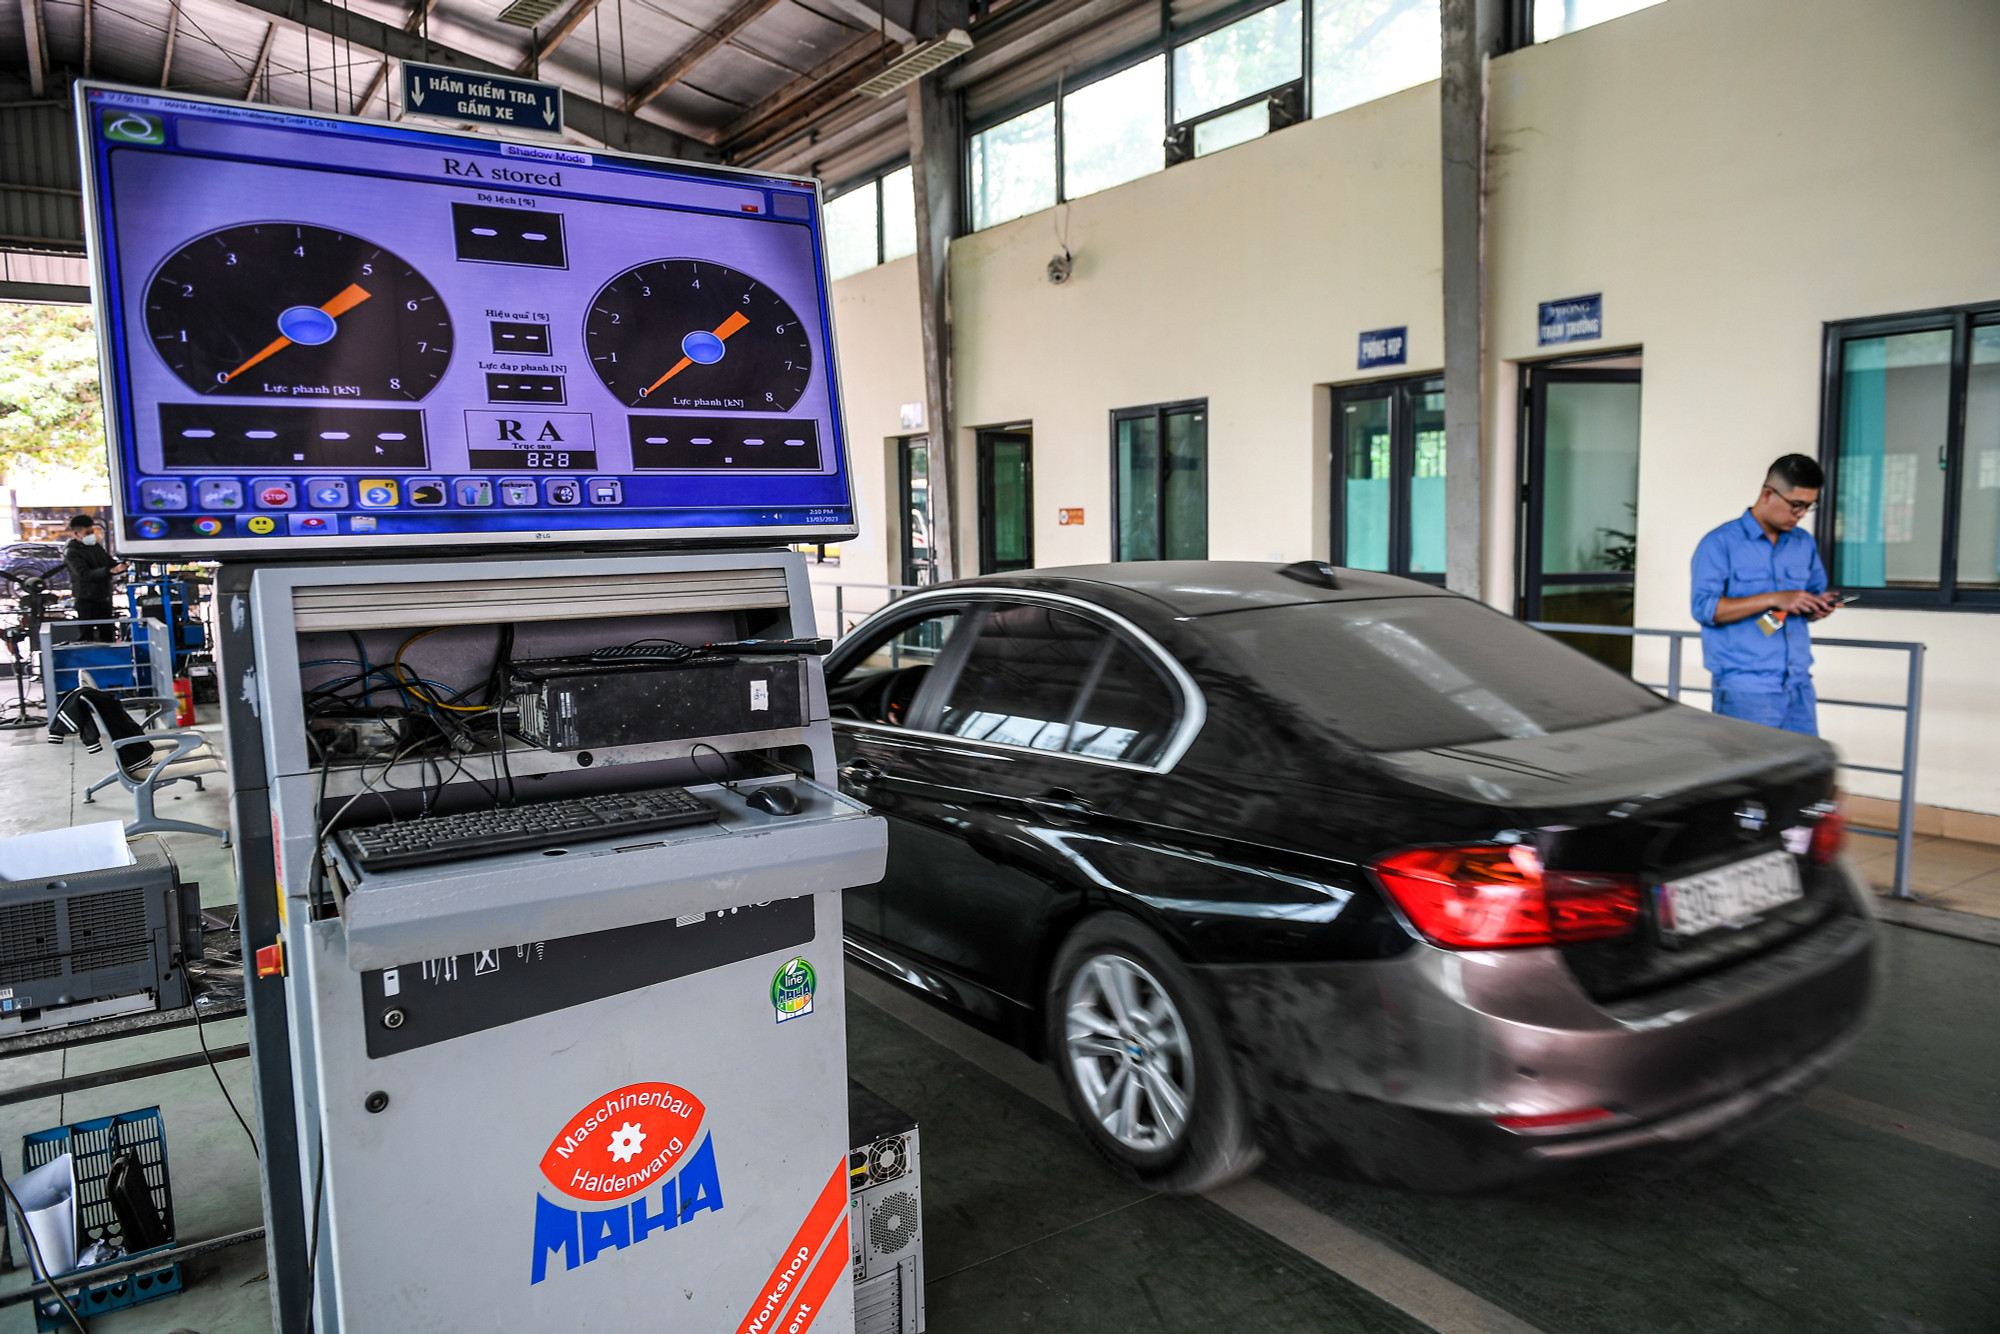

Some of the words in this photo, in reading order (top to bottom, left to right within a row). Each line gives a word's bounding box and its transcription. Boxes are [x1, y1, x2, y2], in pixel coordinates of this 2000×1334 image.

[468, 81, 505, 101] KIỂM
[508, 90, 537, 105] TRA
[495, 106, 514, 120] XE
[508, 146, 552, 159] Shadow
[555, 152, 586, 163] Mode
[443, 158, 484, 178] RA
[491, 168, 562, 187] stored
[477, 193, 492, 202] Độ
[495, 195, 516, 204] lệch
[293, 246, 305, 258] 4
[226, 253, 237, 265] 3
[362, 264, 373, 276] 5
[691, 279, 701, 289] 4
[182, 285, 194, 298] 2
[642, 287, 651, 297] 3
[742, 294, 751, 304] 5
[406, 300, 418, 311] 6
[485, 309, 510, 319] Hiệu
[611, 314, 620, 324] 2
[776, 325, 785, 335] 6
[180, 330, 188, 343] 1
[418, 342, 427, 354] 7
[610, 353, 618, 362] 1
[478, 361, 498, 370] Lực
[500, 363, 519, 372] đạp
[521, 364, 549, 372] phanh
[551, 365, 567, 374] [N]
[785, 361, 793, 371] 7
[216, 372, 229, 385] 0
[390, 378, 401, 390] 8
[263, 383, 288, 394] Lực
[292, 385, 330, 395] phanh
[333, 386, 361, 396] [kN]
[638, 387, 648, 398] 0
[673, 397, 691, 406] Lực
[694, 398, 722, 407] phanh
[723, 399, 744, 408] [kN]
[765, 392, 774, 402] 8
[496, 419, 527, 442] R
[536, 420, 565, 442] A
[511, 442, 535, 450] Trục
[527, 452, 570, 468] 828
[264, 493, 287, 501] STOP
[785, 975, 804, 988] line
[777, 979, 812, 1004] MAHA
[555, 1091, 693, 1159] Maschinenbau
[570, 1136, 683, 1193] Haldenwang
[530, 1128, 724, 1286] MAHA
[745, 1245, 810, 1334] Workshop
[787, 1303, 812, 1334] ent
